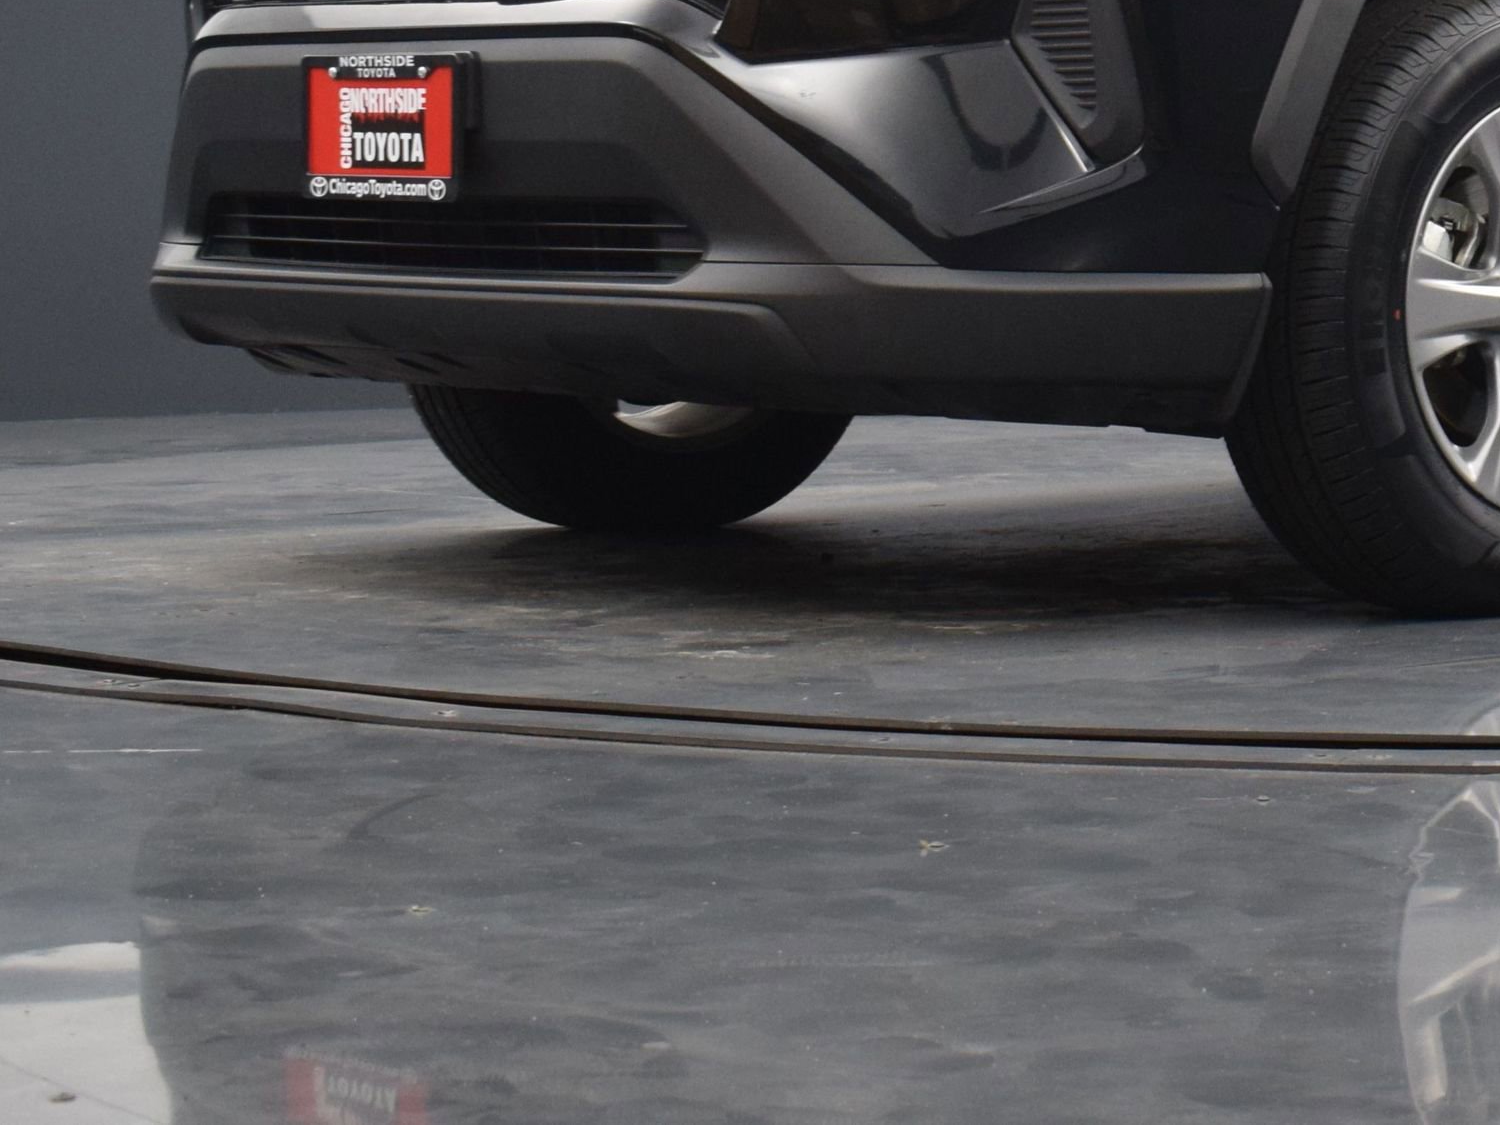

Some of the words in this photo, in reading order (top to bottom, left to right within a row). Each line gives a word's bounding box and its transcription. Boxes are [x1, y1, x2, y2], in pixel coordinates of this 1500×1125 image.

[339, 55, 415, 68] NORTHSIDE
[357, 67, 397, 78] TOYOTA
[351, 87, 427, 114] NORTHSIDE
[339, 87, 352, 169] CHICAGO
[353, 131, 425, 163] TOYOTA
[328, 178, 427, 198] ChicagoToyota.com
